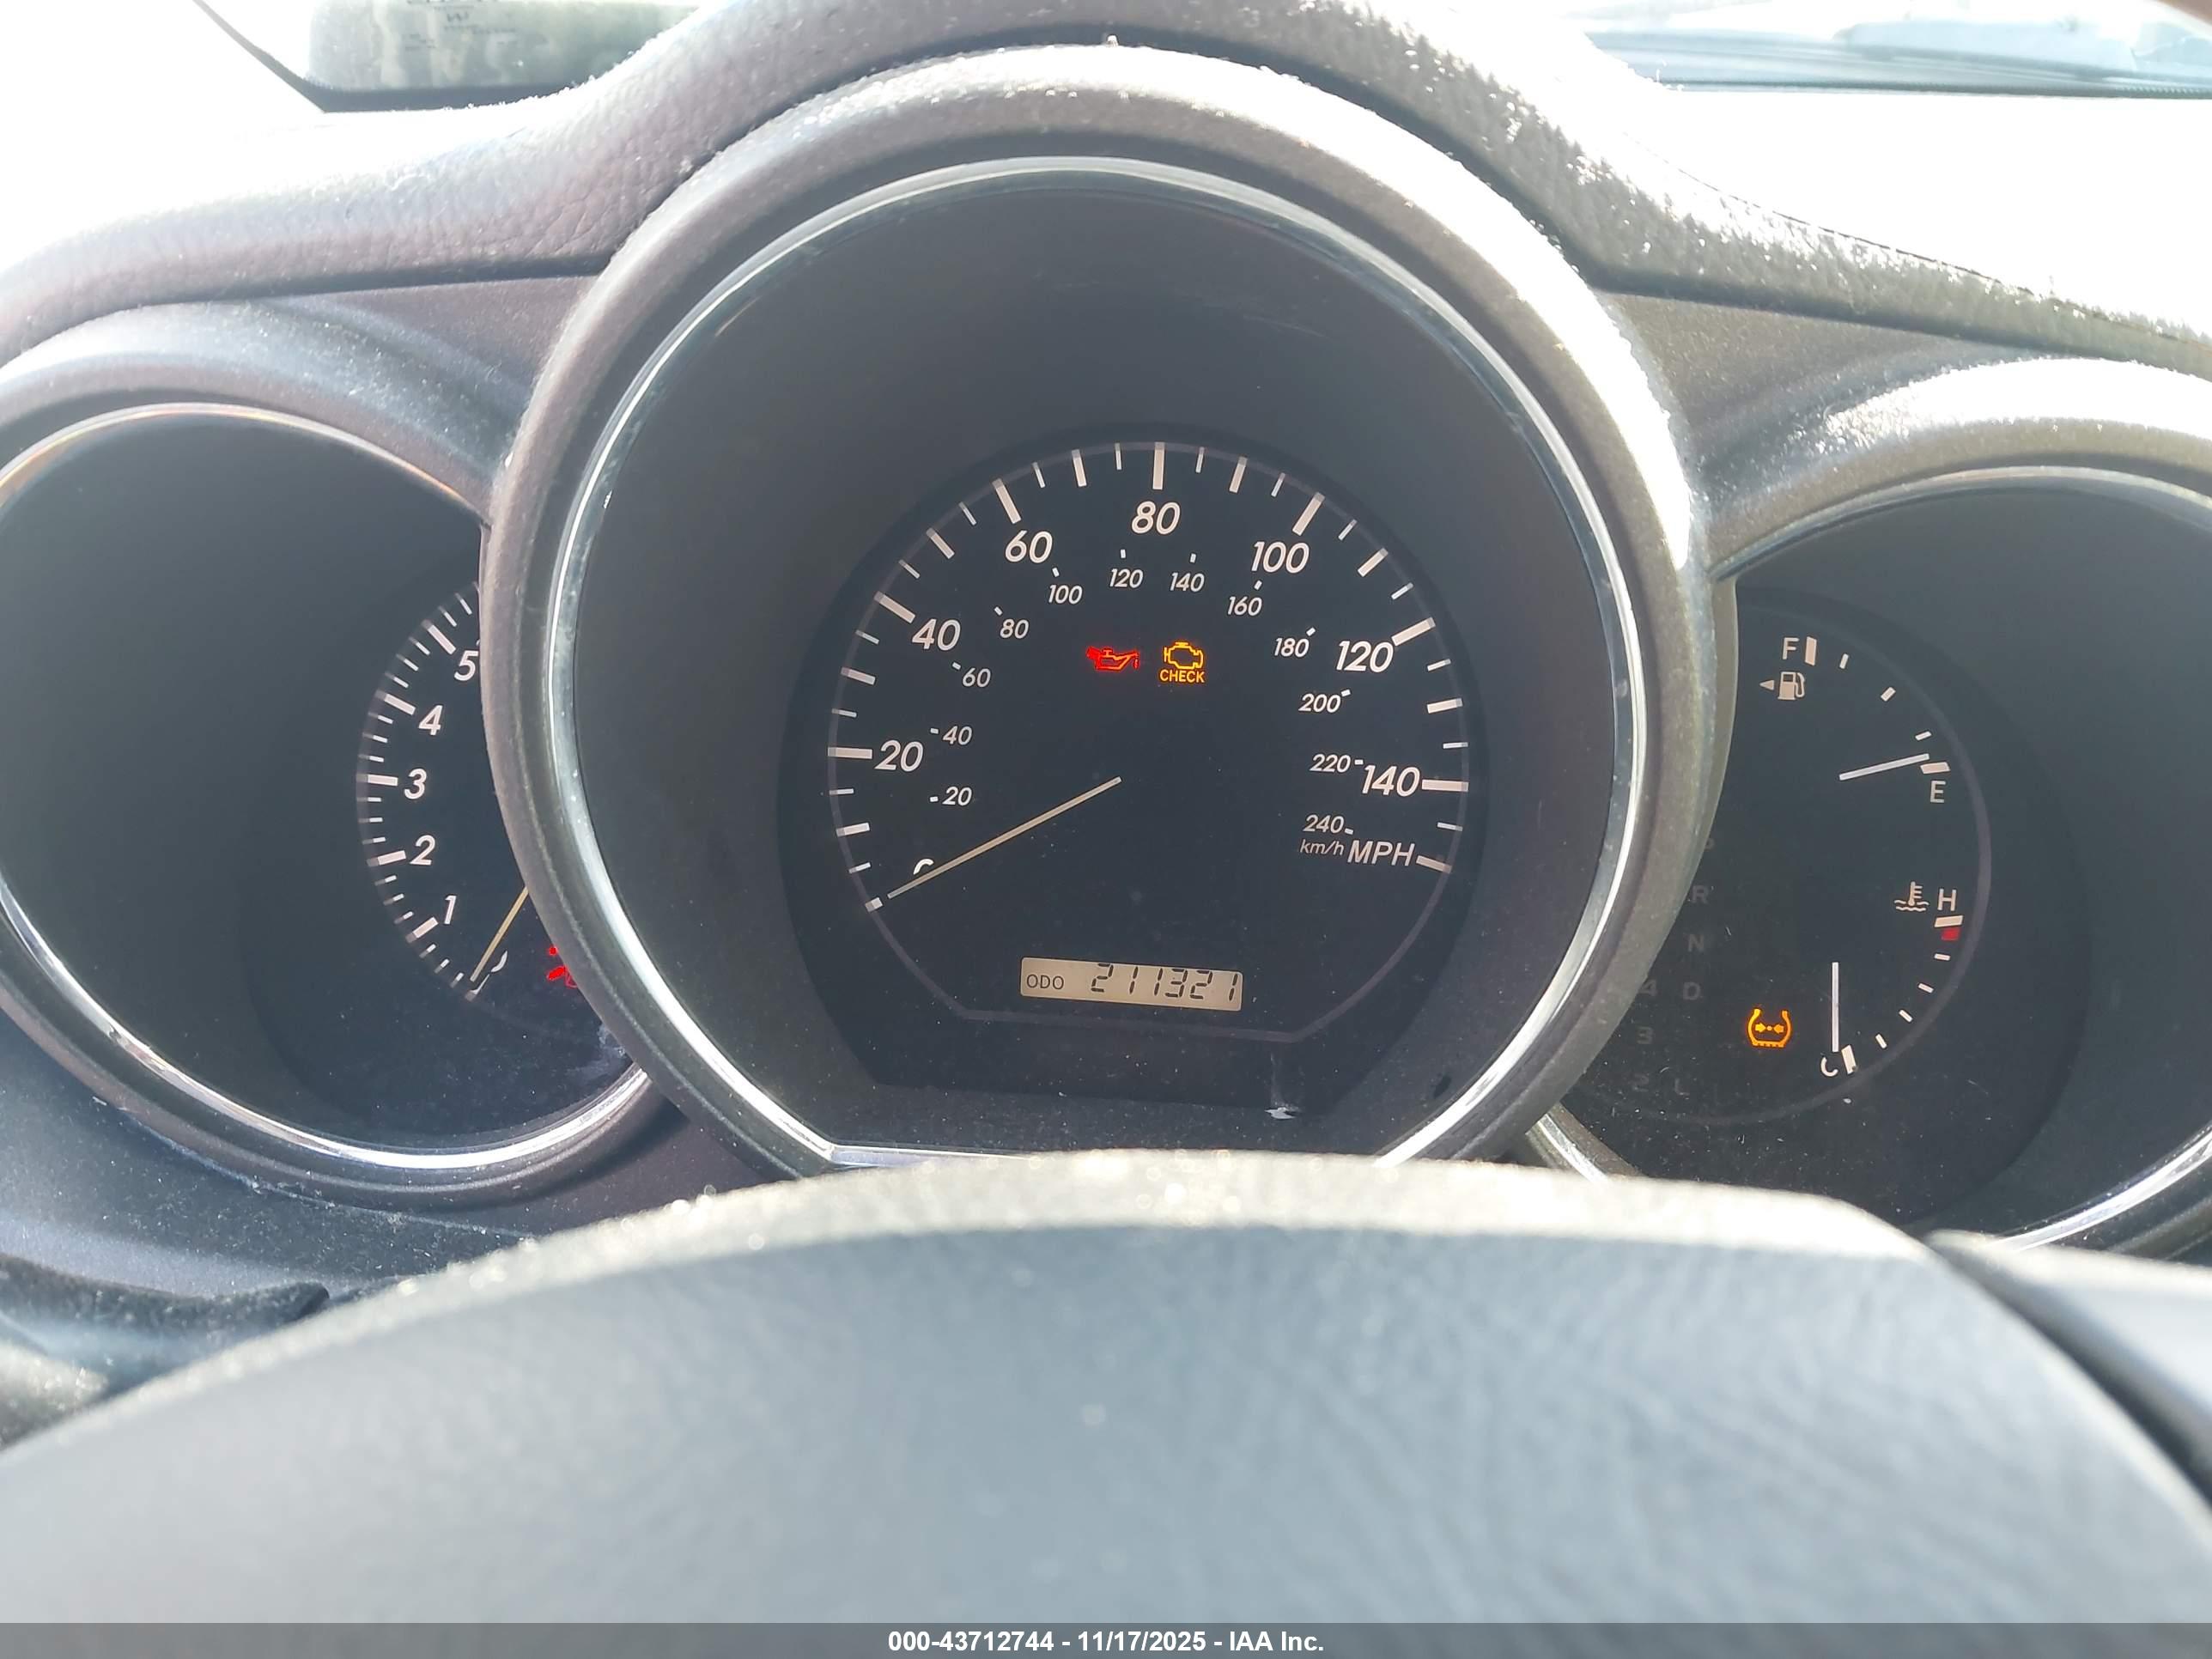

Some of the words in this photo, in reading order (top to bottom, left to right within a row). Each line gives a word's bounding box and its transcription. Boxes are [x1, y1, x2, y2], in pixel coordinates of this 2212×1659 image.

[1130, 500, 1182, 536] 80
[1004, 529, 1054, 564] 60
[1250, 540, 1310, 574] 100
[1109, 568, 1145, 589] 120
[1169, 571, 1206, 593] 140
[1048, 583, 1084, 605] 100
[1226, 595, 1263, 617] 160
[910, 617, 962, 652] 40
[999, 617, 1030, 640] 80
[1273, 636, 1310, 659] 180
[1335, 639, 1395, 673] 120
[1781, 636, 1800, 660] F
[453, 649, 479, 682] 5
[1159, 669, 1205, 684] CHECK
[961, 666, 992, 689] 60
[1297, 692, 1341, 714] 200
[417, 704, 444, 737] 4
[941, 725, 973, 746] 40
[873, 738, 925, 773] 20
[1310, 752, 1352, 774] 220
[403, 767, 428, 800] 3
[1361, 763, 1421, 798] 140
[1929, 779, 1947, 804] E
[941, 785, 973, 807] 20
[1302, 813, 1346, 835] 240
[409, 834, 437, 866] 2
[1298, 838, 1345, 857] km/h
[1346, 839, 1416, 867] MPH
[1691, 884, 1711, 904] R
[1936, 887, 1958, 912] H
[443, 894, 458, 926] 1
[1687, 933, 1705, 952] N
[1025, 973, 1066, 991] ODO
[1090, 962, 1239, 1002] 211321
[1682, 981, 1702, 1000] D
